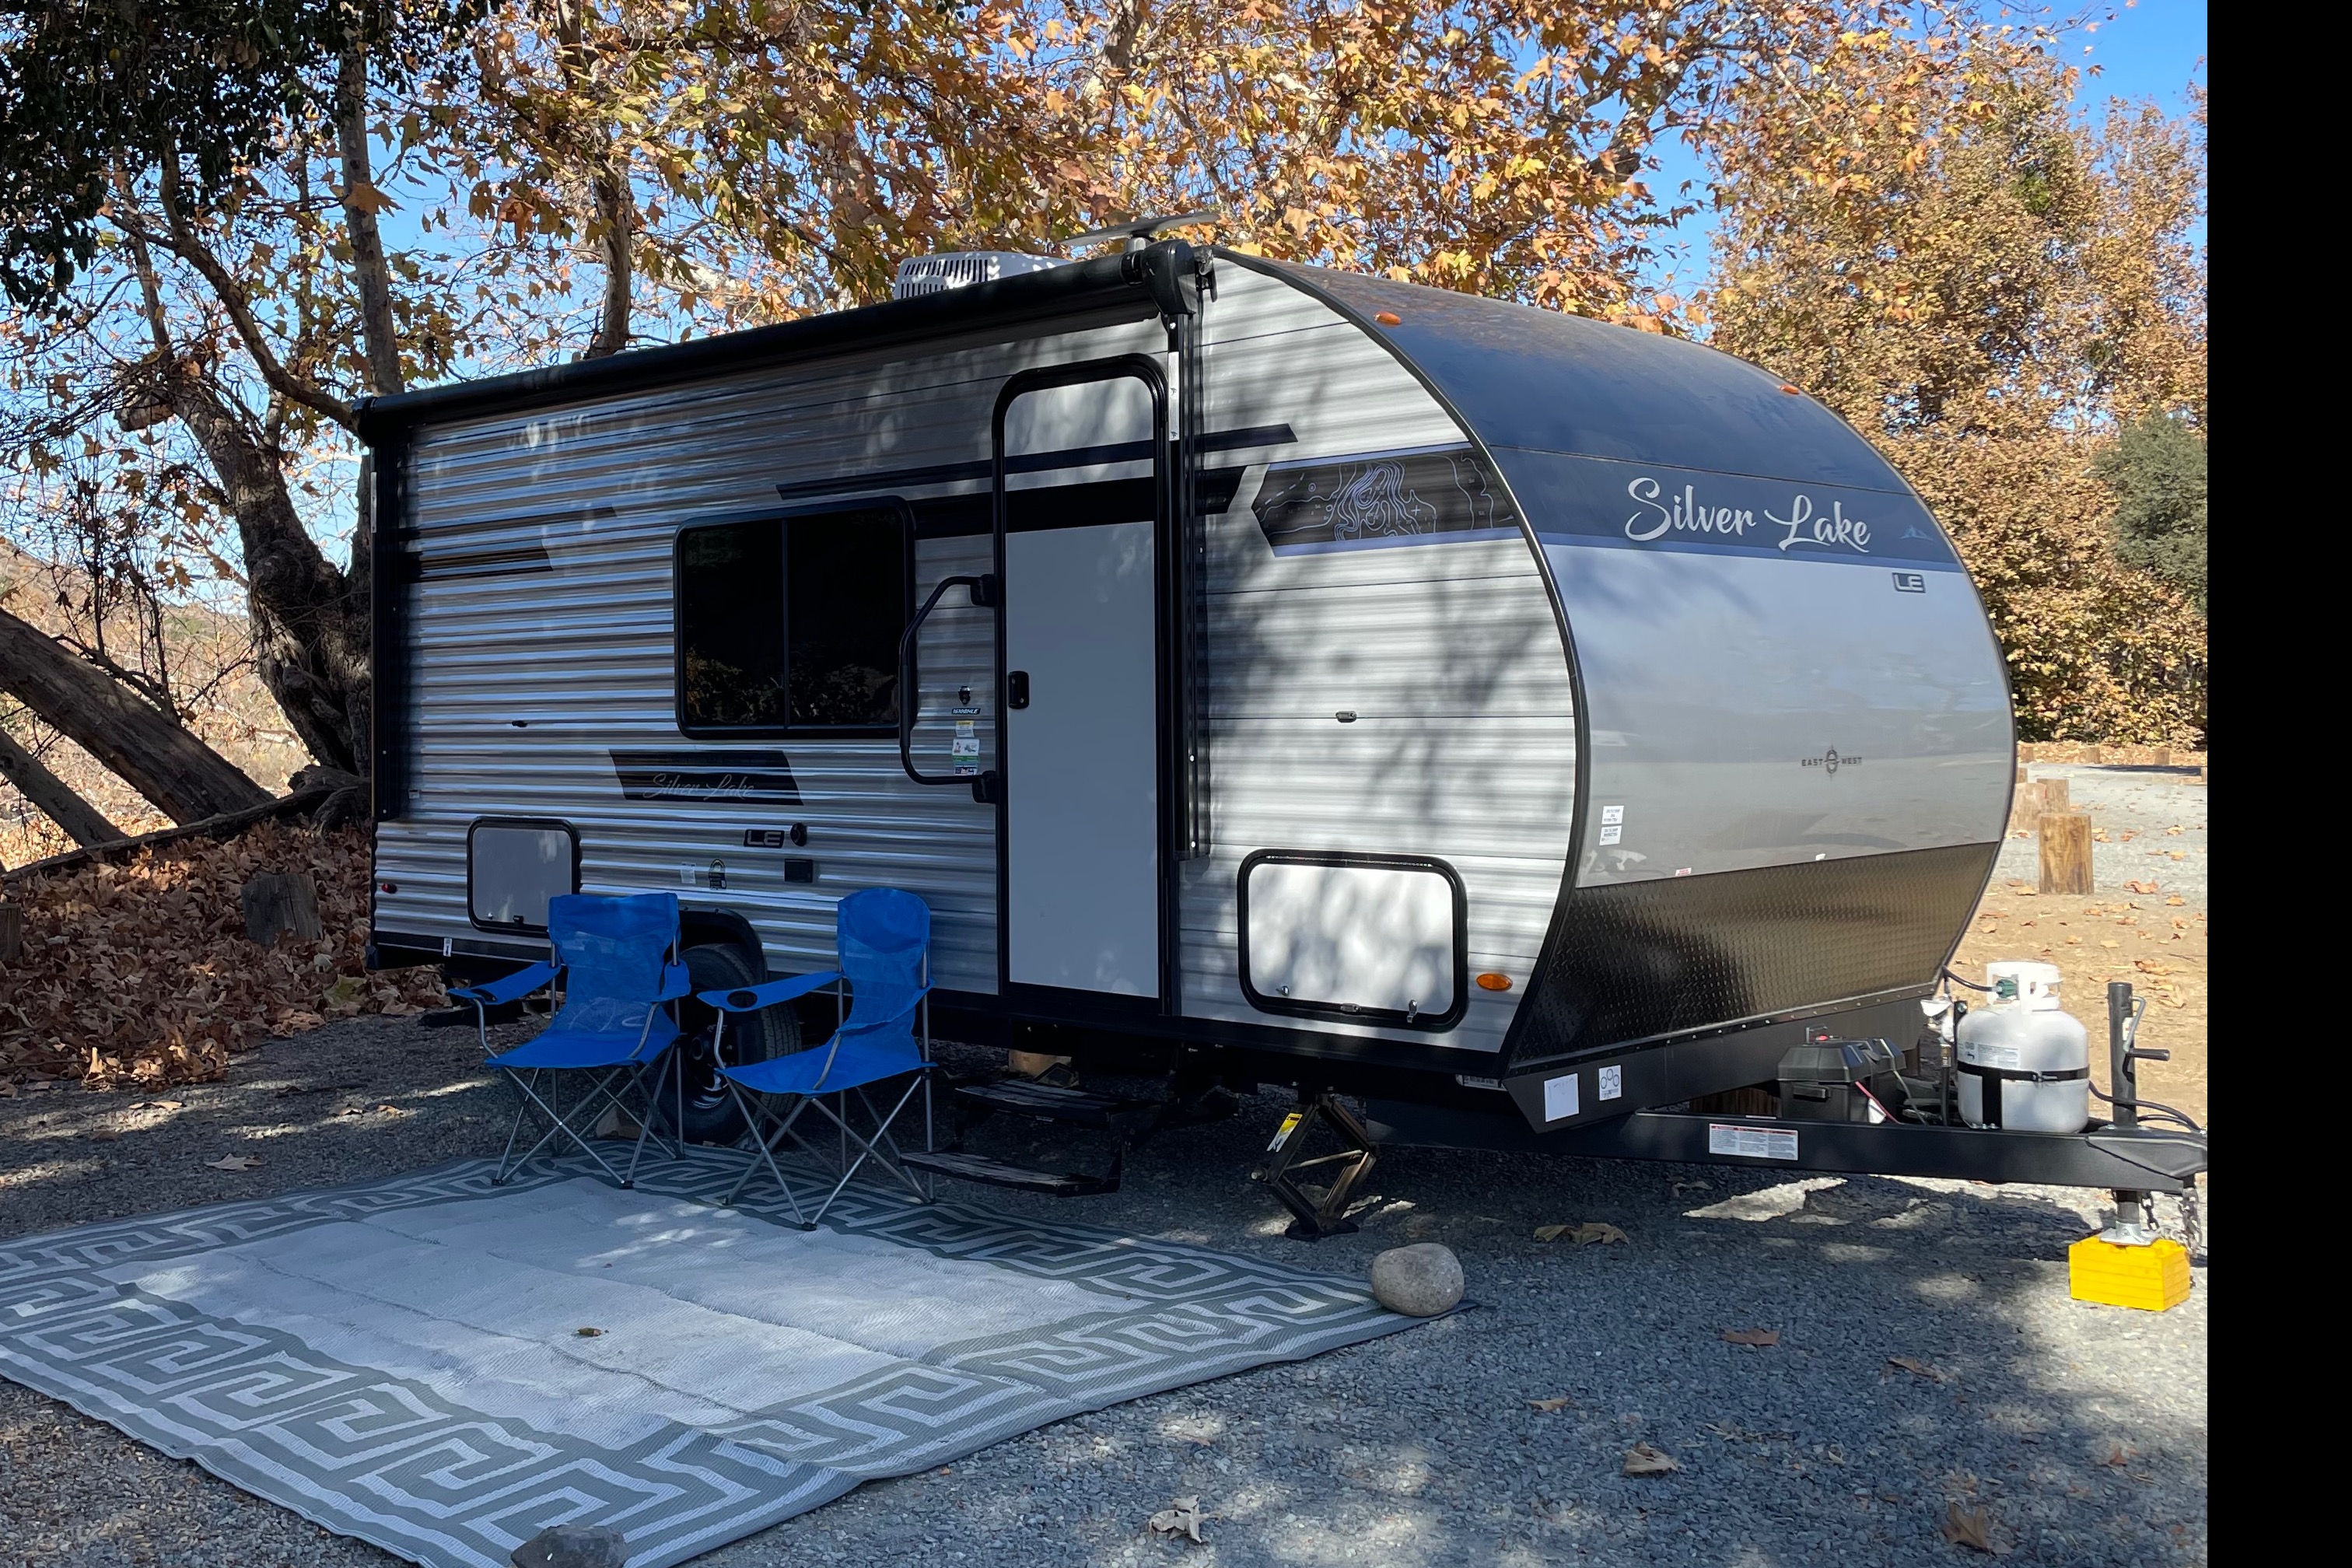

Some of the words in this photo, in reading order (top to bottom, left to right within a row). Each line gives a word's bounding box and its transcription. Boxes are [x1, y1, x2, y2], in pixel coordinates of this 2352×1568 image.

[1624, 477, 1756, 541] Silver
[1763, 494, 1871, 553] Lake
[1894, 574, 1923, 591] LE
[1801, 758, 1823, 767] EAST
[1841, 757, 1862, 765] WEST
[642, 773, 703, 799] Silver
[703, 774, 755, 801] Lake
[746, 830, 782, 846] LE
